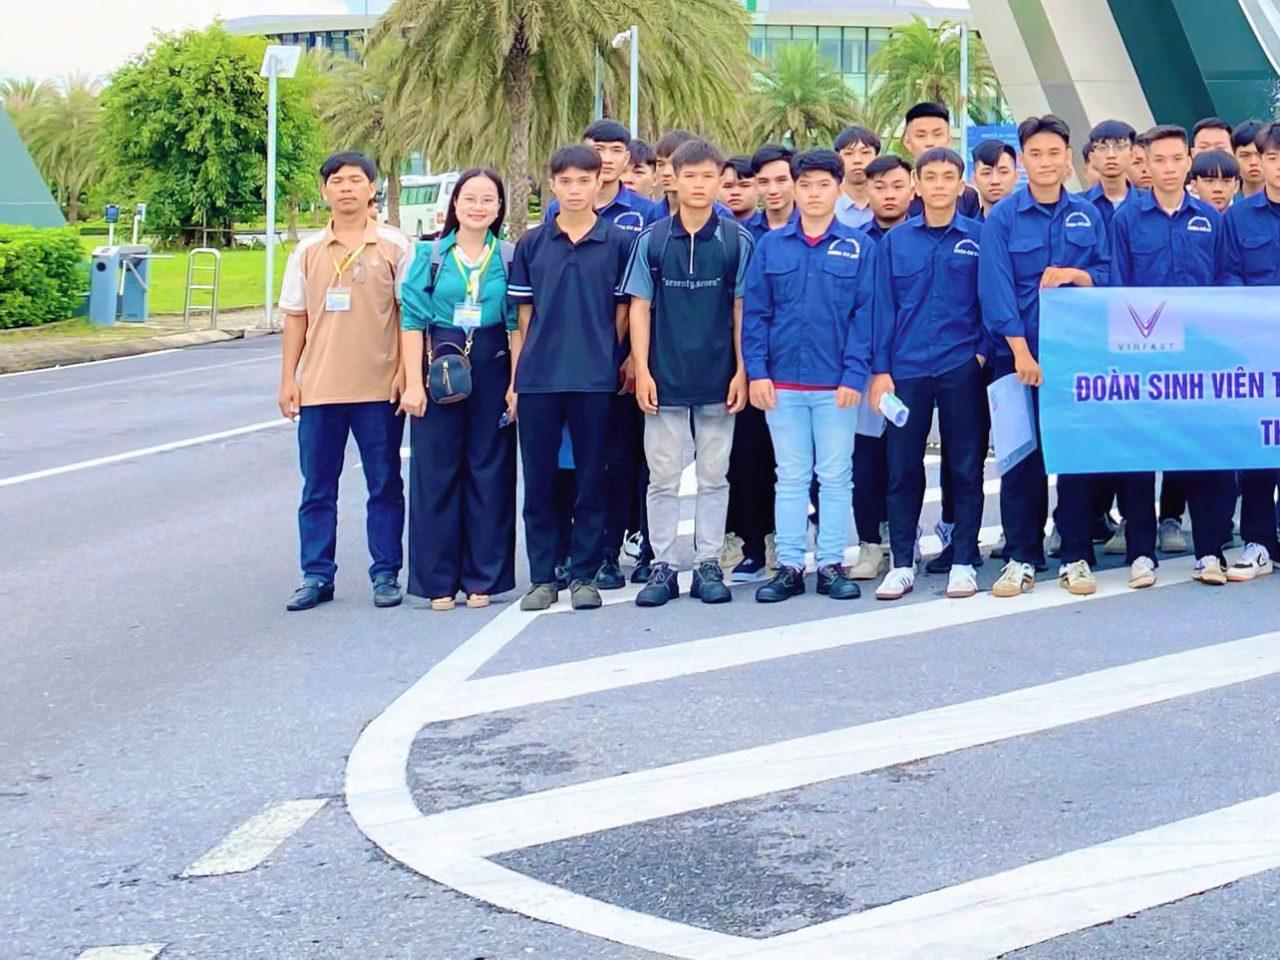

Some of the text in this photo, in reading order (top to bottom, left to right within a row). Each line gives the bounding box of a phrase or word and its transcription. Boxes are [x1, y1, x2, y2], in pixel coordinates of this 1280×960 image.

[1075, 369, 1139, 402] ĐOÀN
[1149, 373, 1203, 400] SINH
[1211, 366, 1264, 398] VIÊN
